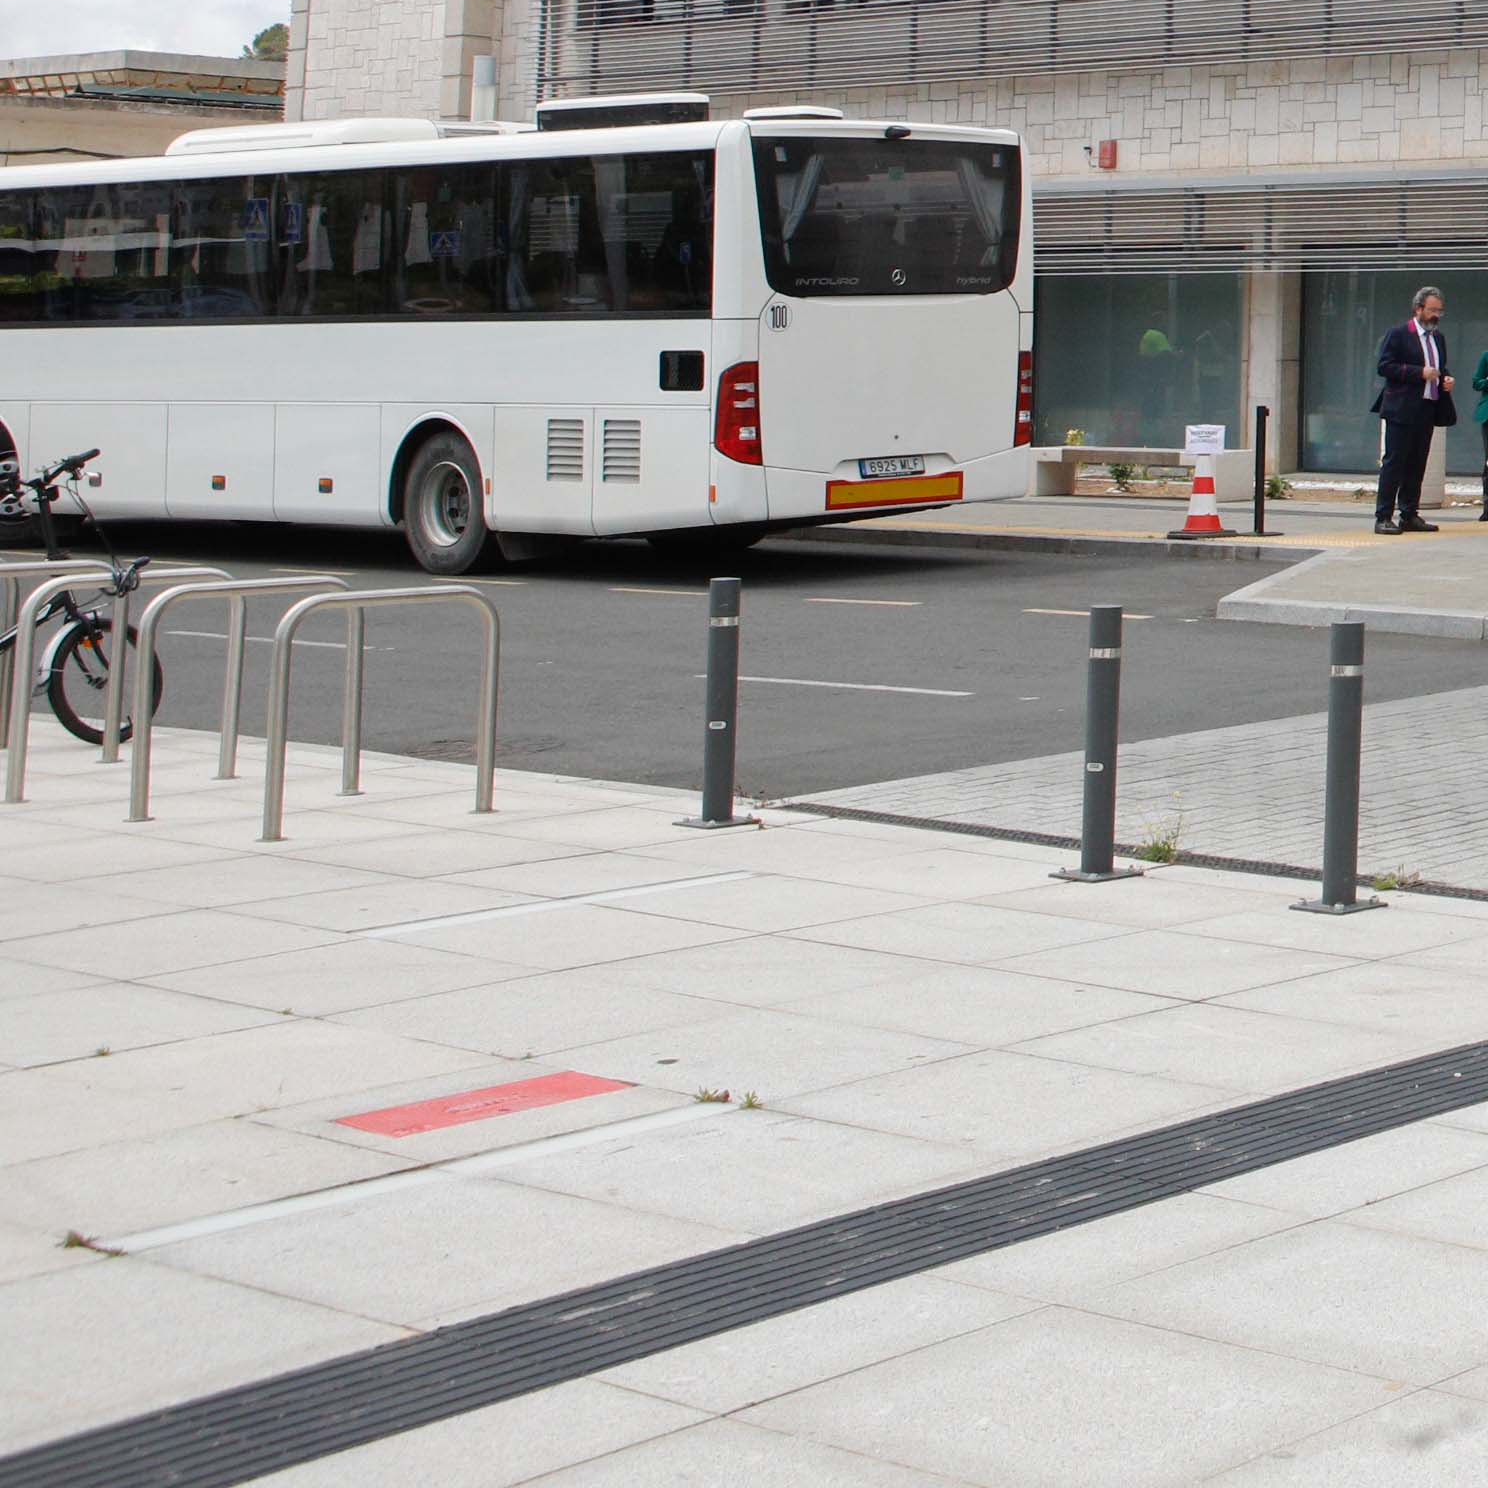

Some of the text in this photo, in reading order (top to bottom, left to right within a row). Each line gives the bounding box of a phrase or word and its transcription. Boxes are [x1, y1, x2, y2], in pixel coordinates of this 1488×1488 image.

[795, 276, 991, 286] INTOURO hybrid
[771, 305, 788, 329] 100
[870, 459, 897, 473] 6925
